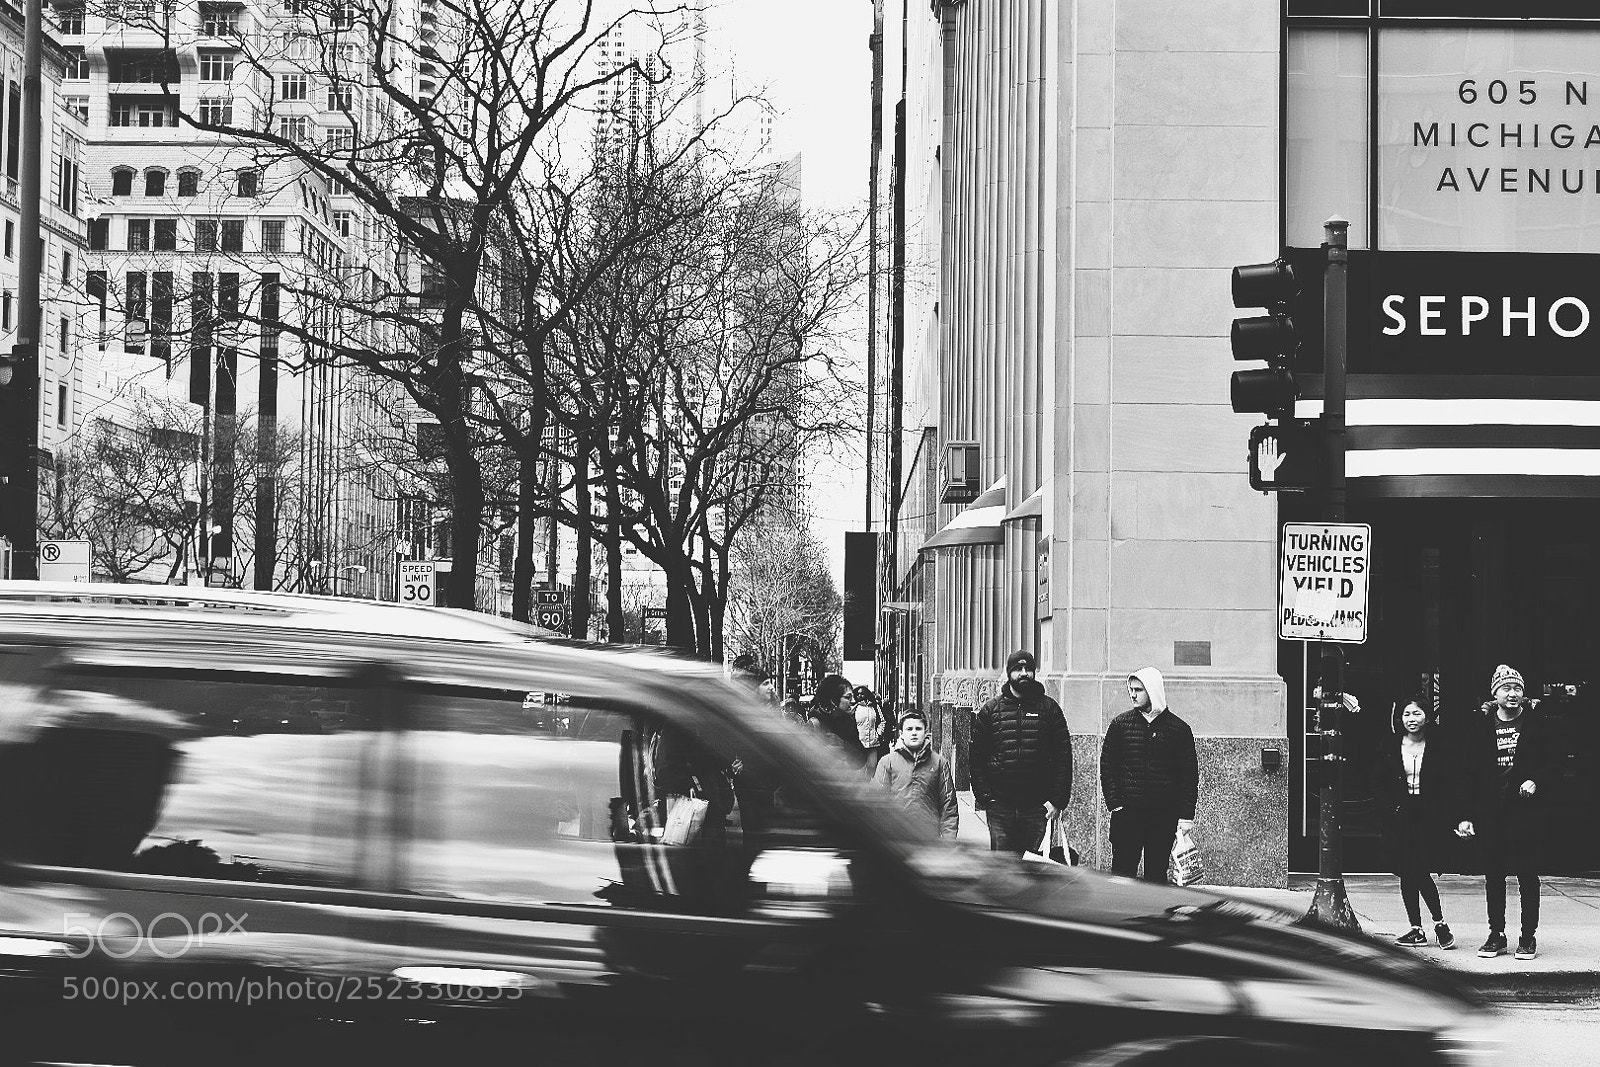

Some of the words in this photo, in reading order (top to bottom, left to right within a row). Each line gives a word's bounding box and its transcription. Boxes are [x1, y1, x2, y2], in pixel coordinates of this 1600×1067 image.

[1458, 79, 1537, 105] 605
[1565, 81, 1587, 105] N
[1413, 122, 1600, 149] MICHIGA
[1436, 167, 1600, 194] AVENU
[1382, 294, 1590, 338] SEPHO
[1288, 533, 1364, 552] TURNING
[402, 565, 433, 573] SPEED
[1286, 554, 1365, 573] VEHICLES
[405, 574, 429, 582] LIMIT
[403, 584, 431, 601] 30
[544, 593, 558, 602] TO
[541, 612, 560, 626] 90
